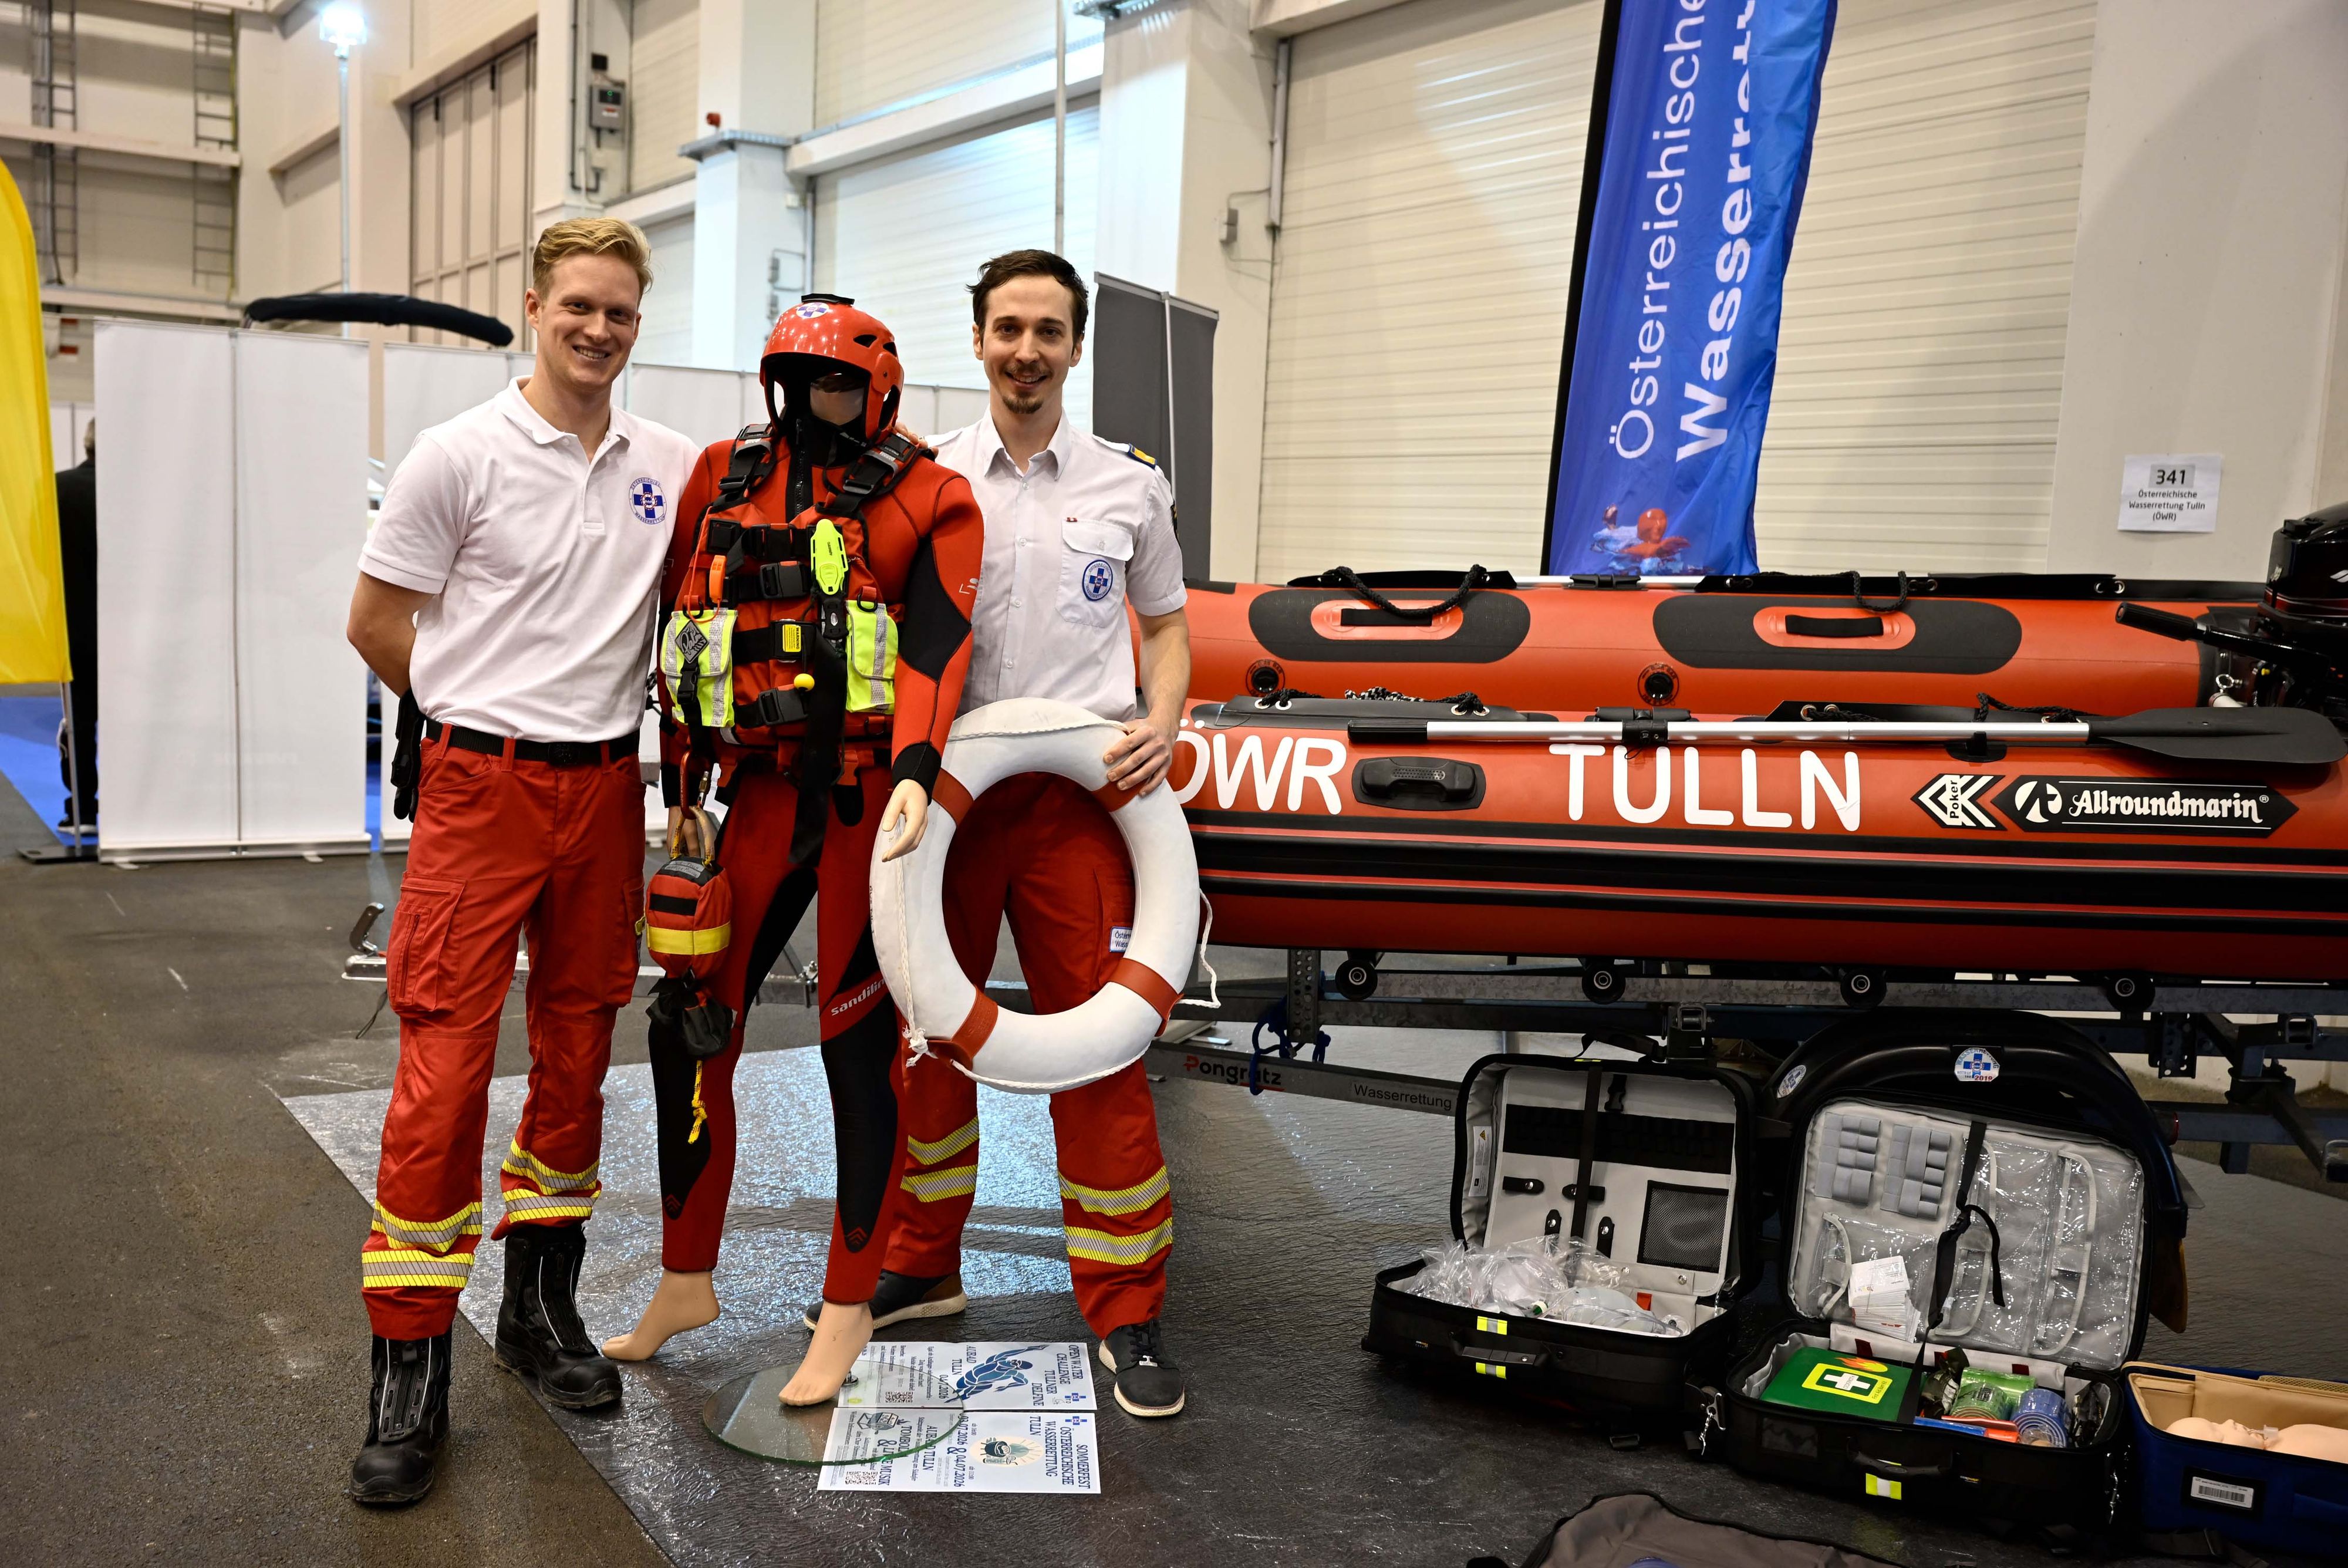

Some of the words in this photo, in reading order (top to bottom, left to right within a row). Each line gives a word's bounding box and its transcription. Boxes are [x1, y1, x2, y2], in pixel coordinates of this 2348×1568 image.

[2155, 469, 2186, 485] 341
[2138, 489, 2198, 498] Österreichische
[2128, 501, 2184, 511] Wasserrettung
[2187, 501, 2205, 510] Tulln
[2153, 512, 2177, 522] (ÖWR)
[1173, 719, 1347, 815] ÖWR
[1549, 744, 1861, 832] TULLN
[1950, 780, 1958, 819] Poker
[1354, 1084, 1452, 1111] Wasserrettung
[966, 1345, 977, 1364] AUBAD
[1068, 1344, 1081, 1361] OPEN
[952, 1358, 963, 1375] TULLN
[1057, 1353, 1071, 1385] CHALLENGE
[1071, 1360, 1084, 1380] WATER
[1044, 1370, 1057, 1394] TULLNER
[1031, 1382, 1044, 1407] DELFINE
[957, 1415, 969, 1445] 03.07.2026
[1030, 1416, 1041, 1436] TULLN
[947, 1446, 967, 1455] &
[1045, 1421, 1058, 1477] WASSERRETTUNG
[1060, 1427, 1074, 1485] ÖSTERREICHISCHE
[922, 1451, 936, 1471] TULLN
[954, 1455, 966, 1487] 04.07.2026
[1076, 1444, 1091, 1489] SOMMERFEST
[878, 1465, 892, 1486] MUSIK
